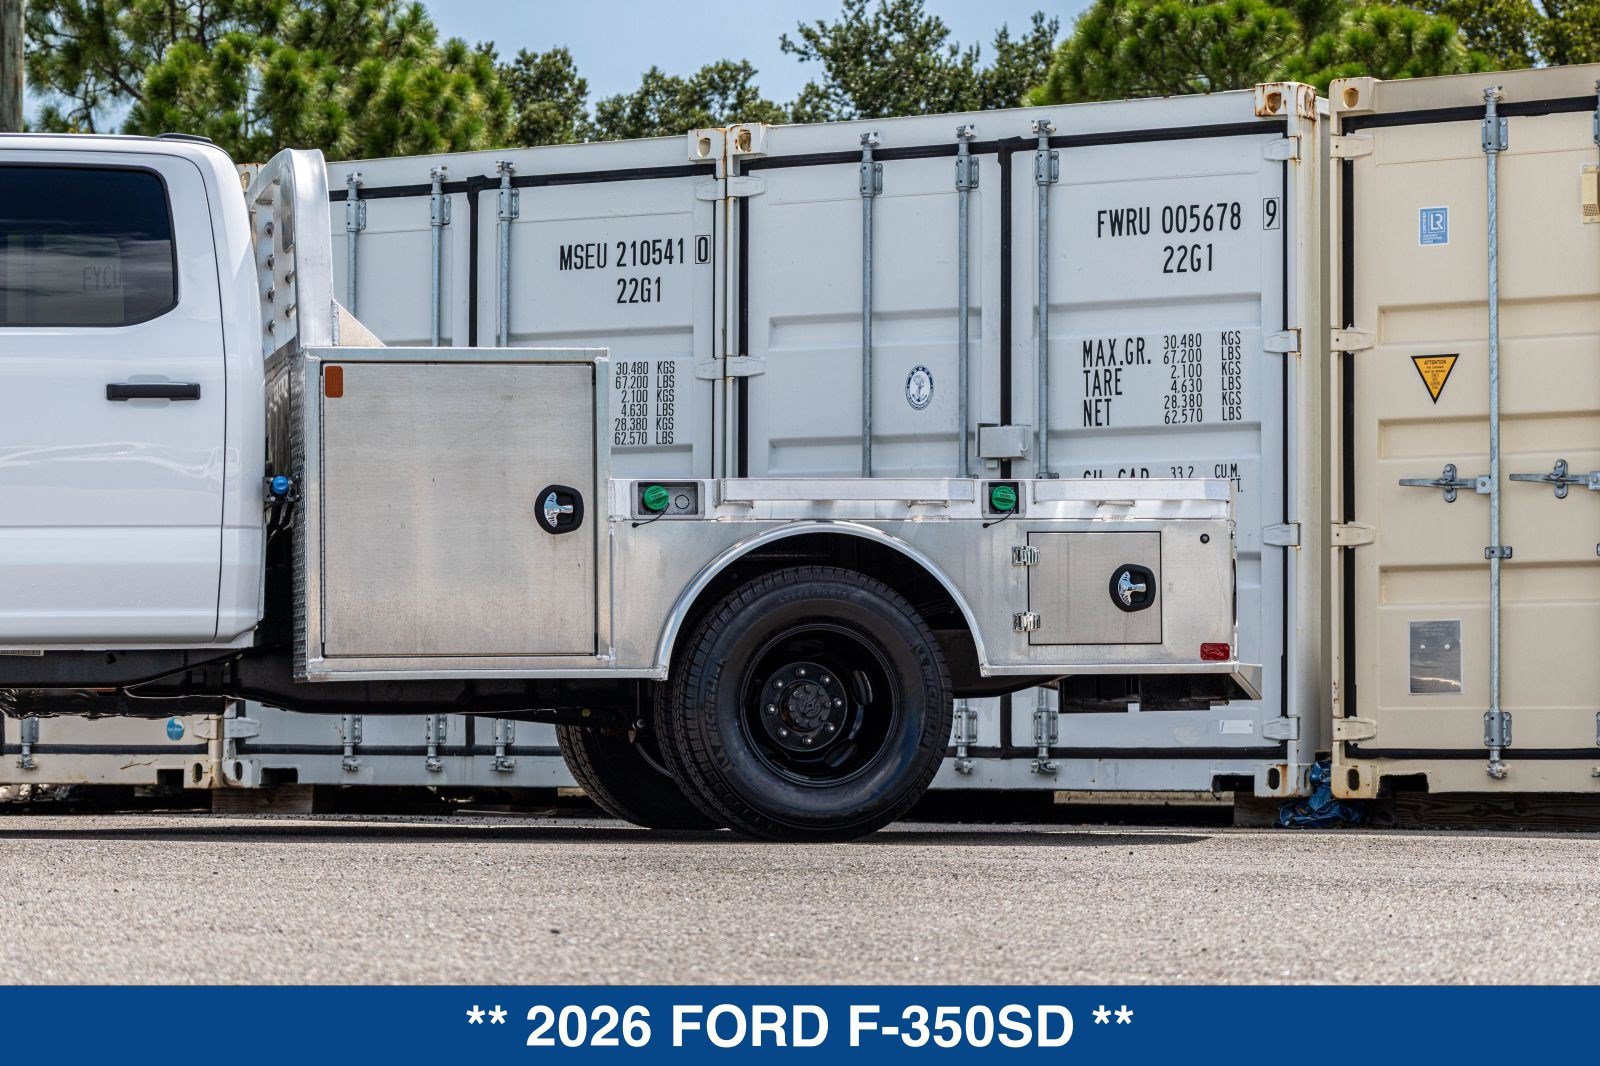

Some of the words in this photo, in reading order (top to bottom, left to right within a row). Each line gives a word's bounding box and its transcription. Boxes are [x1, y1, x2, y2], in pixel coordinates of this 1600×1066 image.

[1098, 207, 1150, 238] FWRU
[1162, 202, 1241, 234] 005678
[1266, 199, 1277, 228] 9
[560, 243, 607, 270] MSEU
[617, 238, 683, 267] 210541
[697, 236, 708, 262] 0
[1163, 243, 1212, 273] 22G1
[617, 277, 660, 304] 22G1
[1083, 337, 1151, 368] MAX.GR.
[1164, 333, 1201, 350] 30.480
[1222, 331, 1240, 345] KGS
[1164, 348, 1202, 365] 67.200
[1222, 346, 1241, 361] LBS
[616, 362, 648, 376] 30.480
[657, 361, 675, 374] KGS
[616, 375, 648, 389] 67.200
[657, 375, 674, 388] LBS
[1083, 367, 1122, 397] TARE
[1171, 364, 1202, 379] 2.100
[1222, 361, 1241, 376] KGS
[1171, 378, 1202, 394] 4.630
[1222, 376, 1241, 391] LBS
[622, 389, 648, 404] 2.100
[657, 389, 674, 402] KGS
[621, 403, 648, 418] 4.630
[657, 403, 674, 416] LBS
[1084, 398, 1111, 427] NET
[1164, 393, 1202, 410] 28.380
[1222, 391, 1241, 406] KGS
[1164, 408, 1202, 424] 62.570
[1222, 406, 1241, 421] LBS
[615, 417, 647, 431] 28.380
[656, 417, 673, 430] KGS
[615, 431, 647, 446] 62.570
[656, 431, 673, 445] LBS
[1170, 466, 1193, 478] 332
